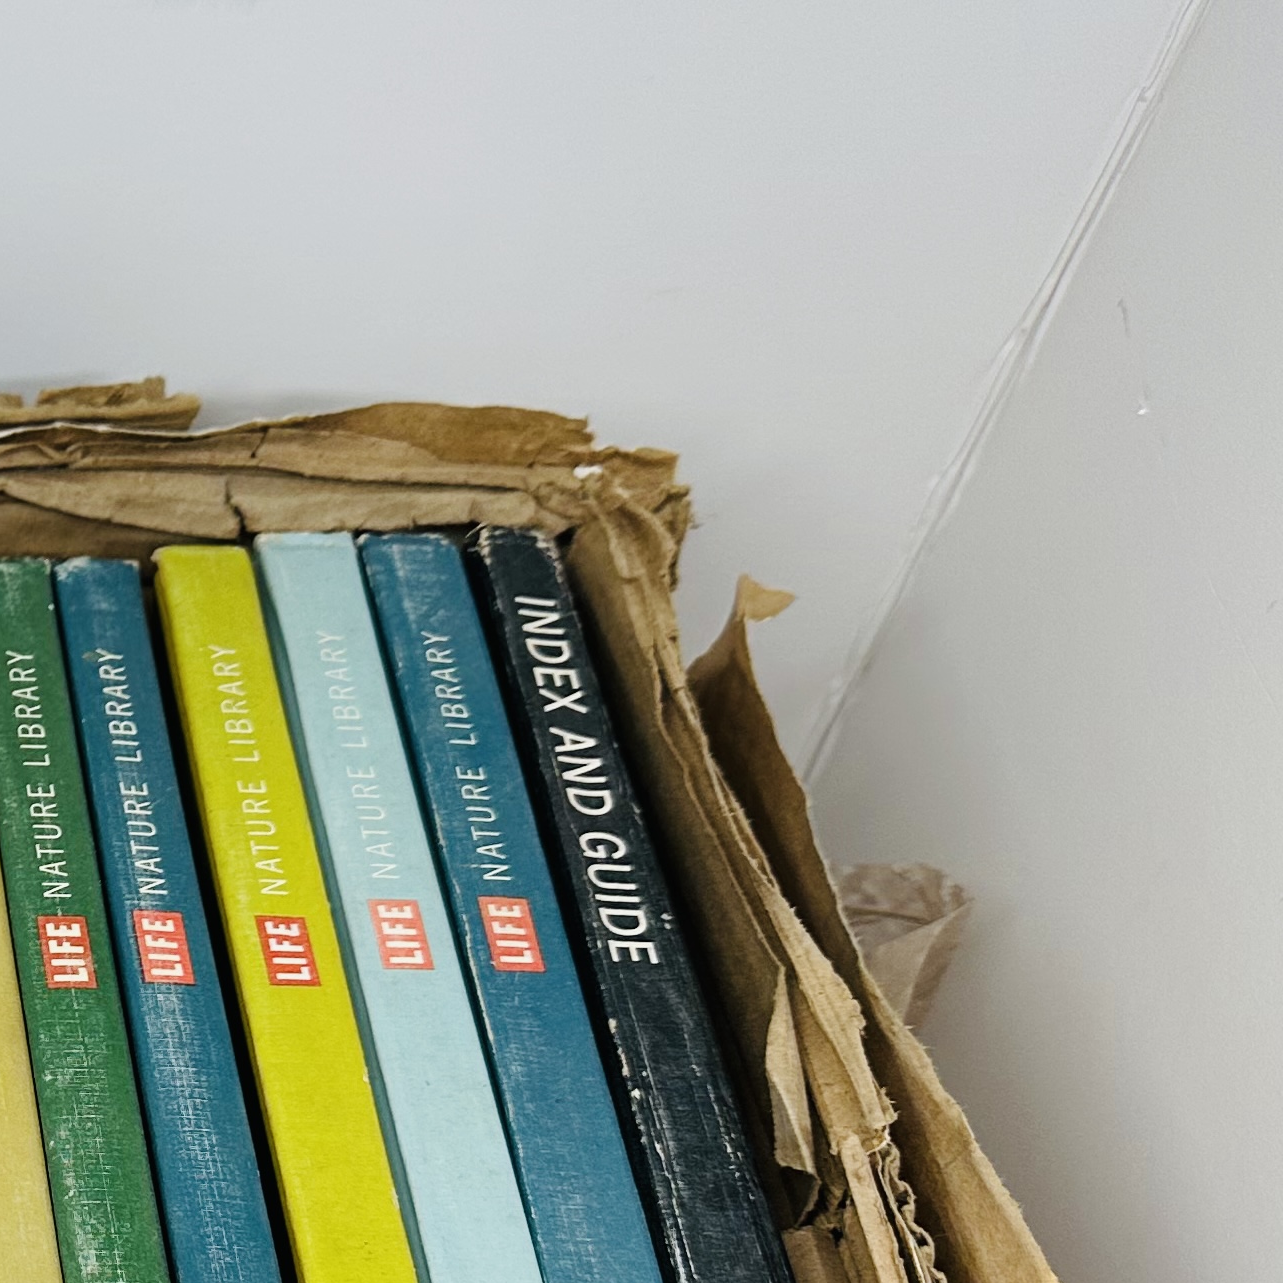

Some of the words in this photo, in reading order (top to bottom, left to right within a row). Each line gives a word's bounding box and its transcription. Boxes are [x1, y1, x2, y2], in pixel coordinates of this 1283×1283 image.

[6, 650, 51, 767] LIBRARY
[96, 648, 142, 762] LIBRARY
[208, 645, 260, 762] LIBRARY
[316, 631, 367, 748] LIBRARY
[422, 631, 480, 745] LIBRARY
[515, 595, 589, 714] INDEX
[350, 765, 400, 879] NATURE
[456, 766, 512, 881] NATURE
[548, 726, 614, 816] AND
[26, 783, 72, 899] NATURE
[123, 781, 168, 896] NATURE
[241, 779, 289, 896] NATURE
[45, 918, 89, 984] LIFE
[141, 913, 185, 980] LIFE
[265, 919, 313, 982] LIFE
[376, 902, 424, 964] LIFE
[486, 900, 533, 968] LIFE
[577, 831, 659, 966] GUIDE
